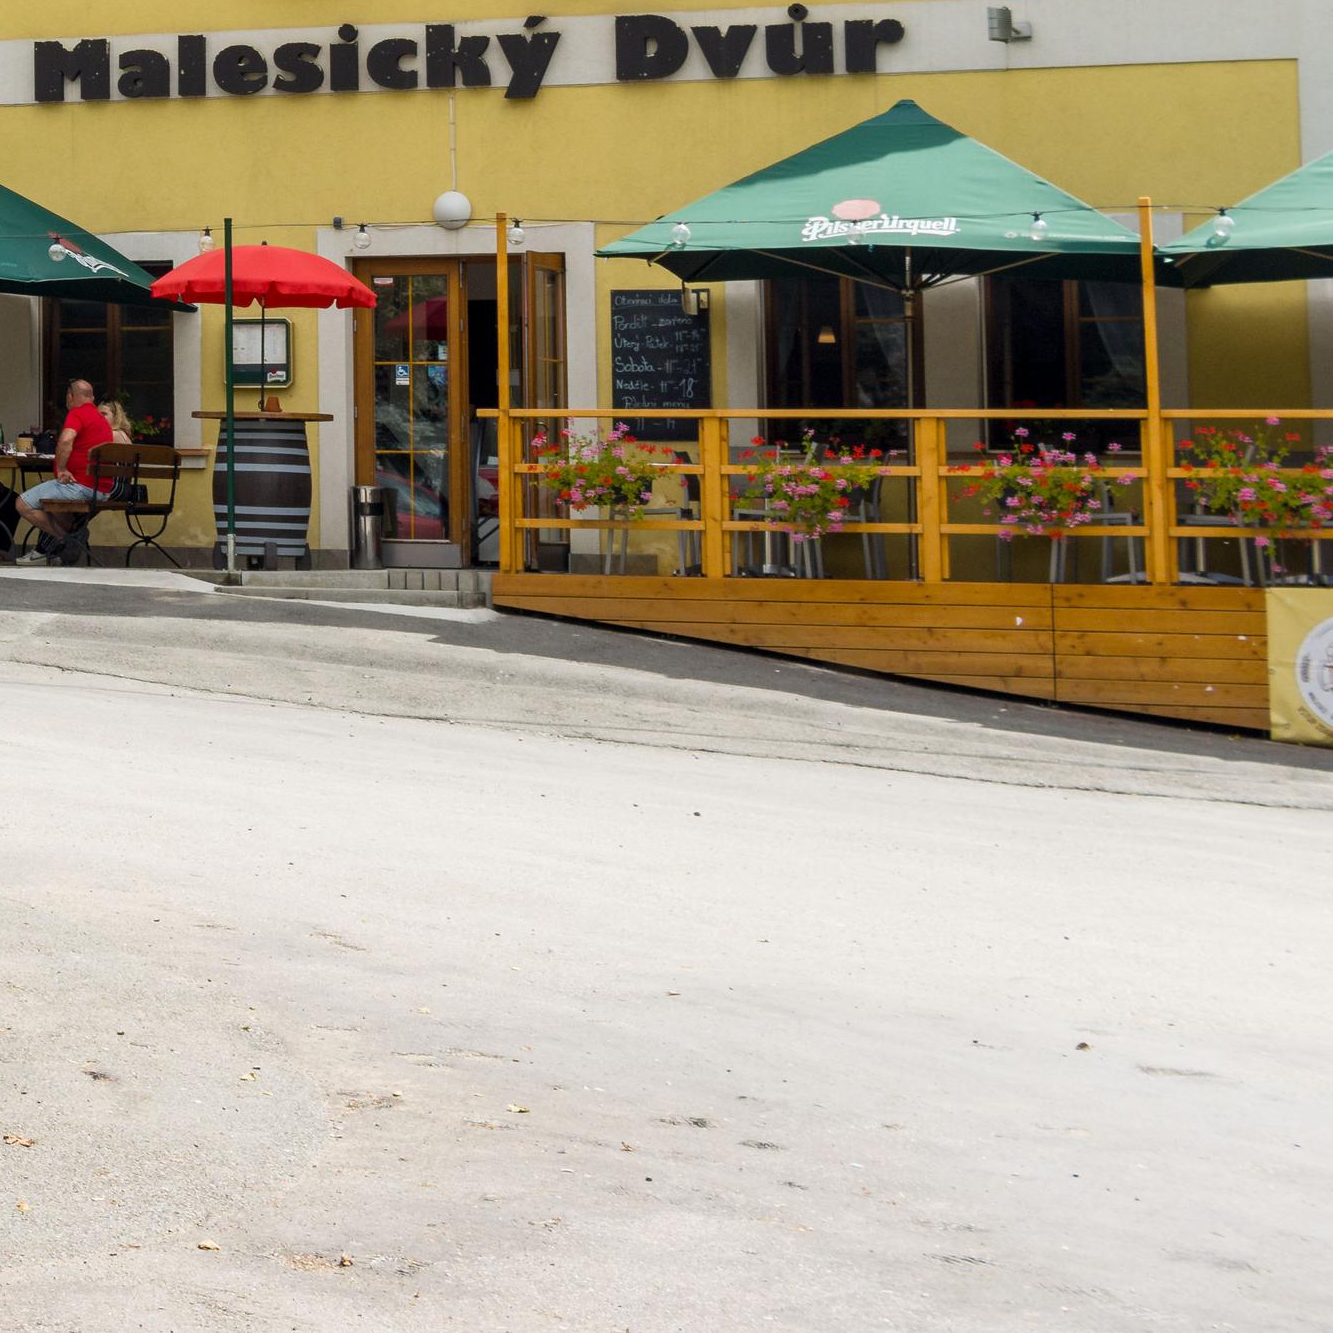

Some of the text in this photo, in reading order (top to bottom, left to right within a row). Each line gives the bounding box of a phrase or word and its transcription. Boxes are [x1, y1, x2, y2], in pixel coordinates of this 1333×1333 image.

[34, 3, 905, 101] Malesický Dvůr
[880, 213, 957, 236] Urquell
[615, 355, 656, 373] Sobota
